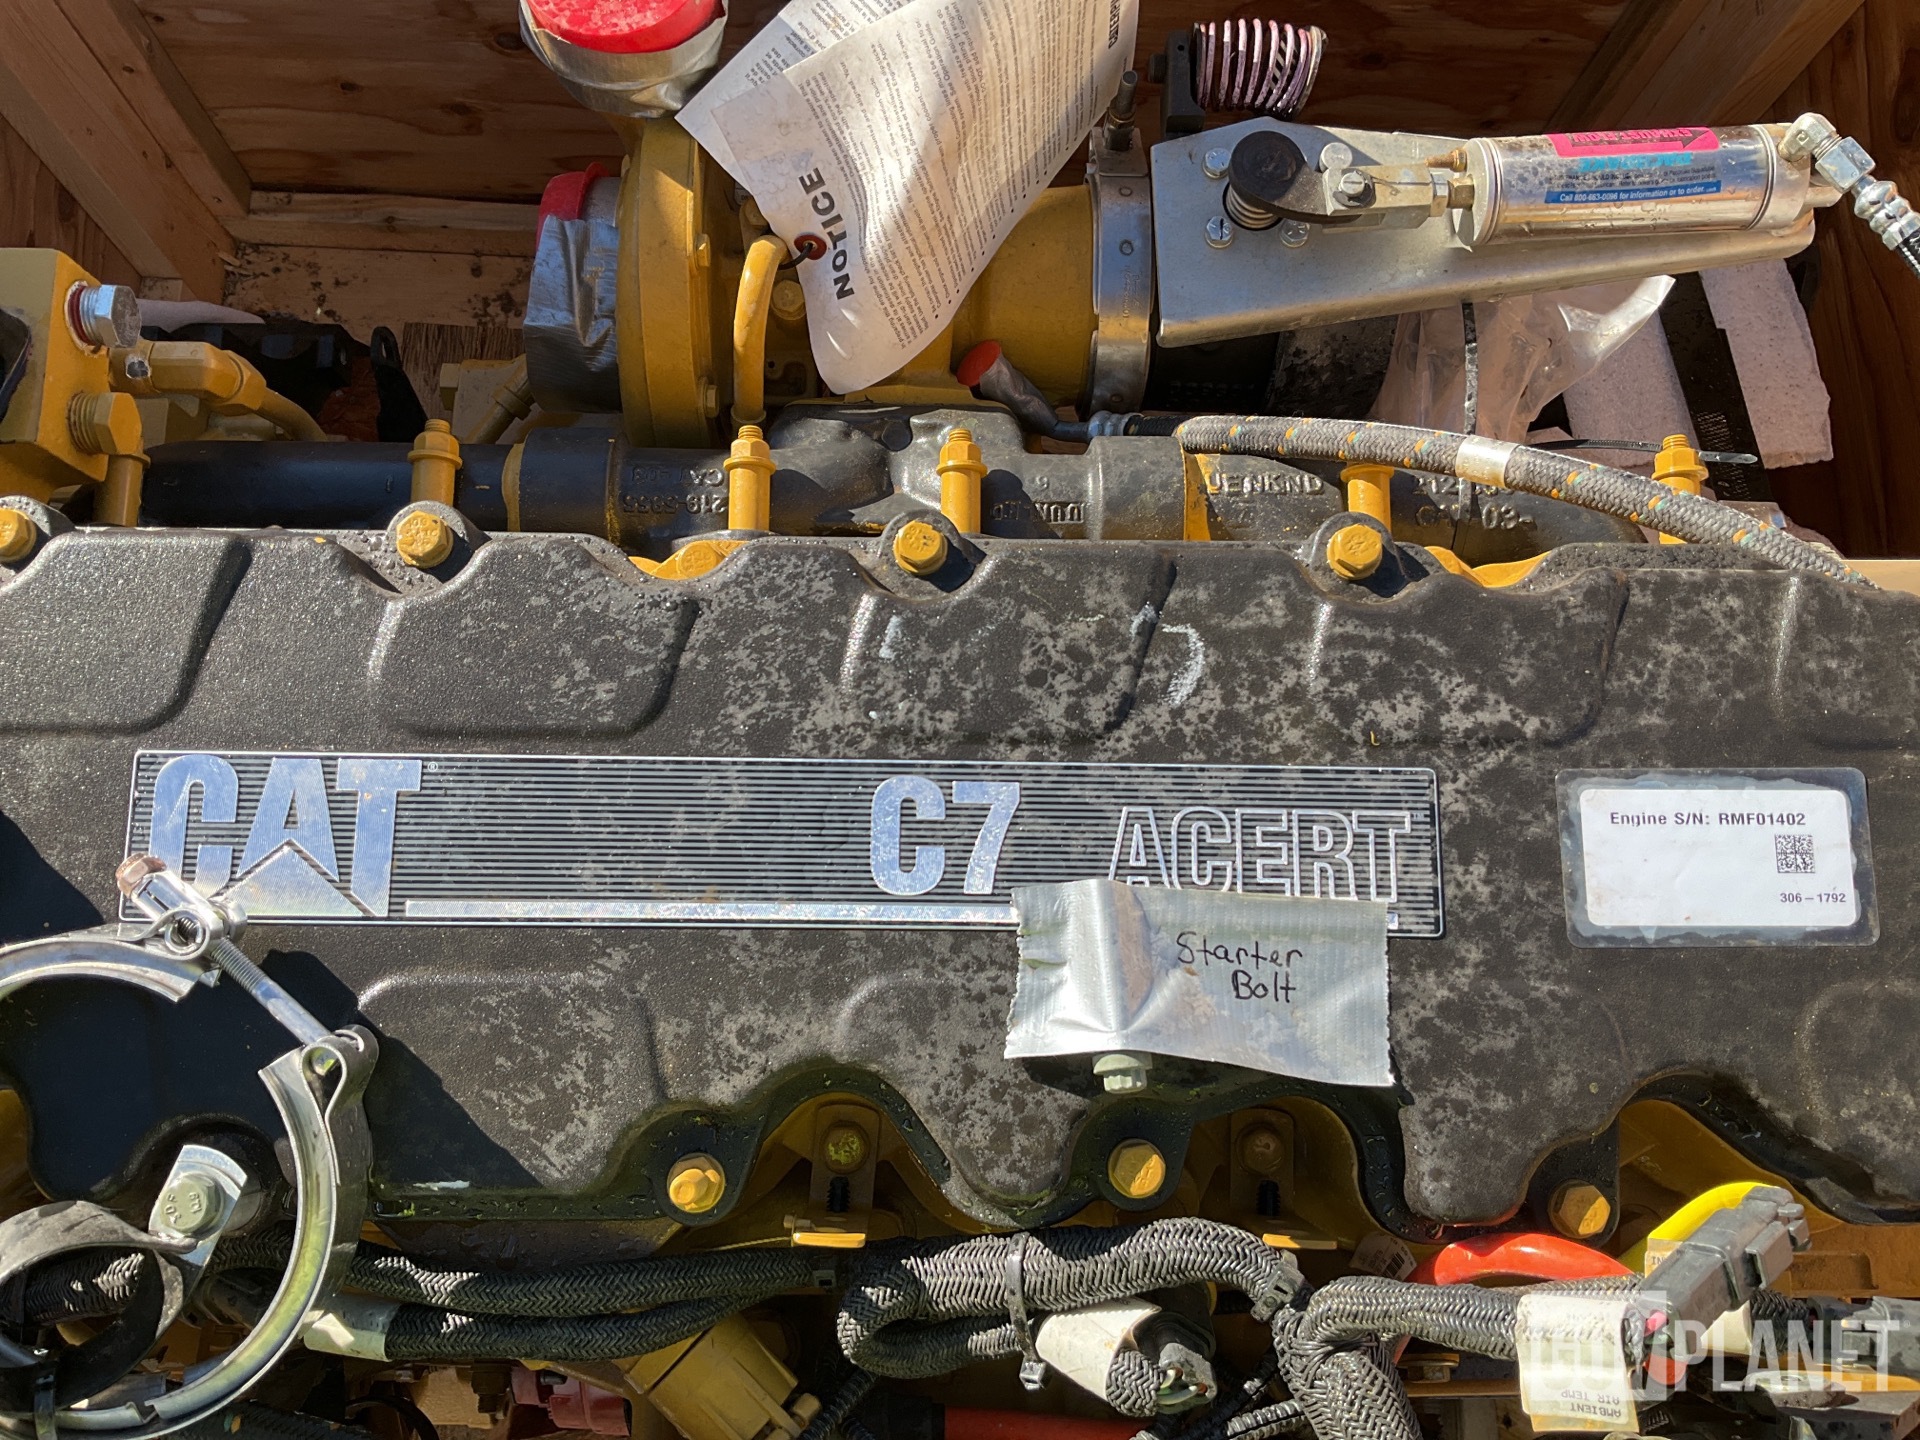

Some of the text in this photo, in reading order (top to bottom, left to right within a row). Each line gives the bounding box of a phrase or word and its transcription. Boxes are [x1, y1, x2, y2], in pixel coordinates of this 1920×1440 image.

[1573, 128, 1694, 143] EXHAUST FLOW
[1560, 193, 1573, 202] Call
[1619, 191, 1629, 200] for
[1629, 189, 1668, 200] information
[1677, 187, 1686, 195] to
[799, 167, 855, 301] NOTICE
[149, 754, 422, 917] CAT
[870, 775, 1020, 895] C7
[1610, 811, 1806, 827] Engine S/N: RMF01402
[1110, 806, 1412, 903] ACERT
[1176, 931, 1305, 965] Starter
[1232, 969, 1298, 1002] Bolt
[1561, 1390, 1620, 1405] AIR TEMP
[1570, 1404, 1622, 1418] AMBIENT
